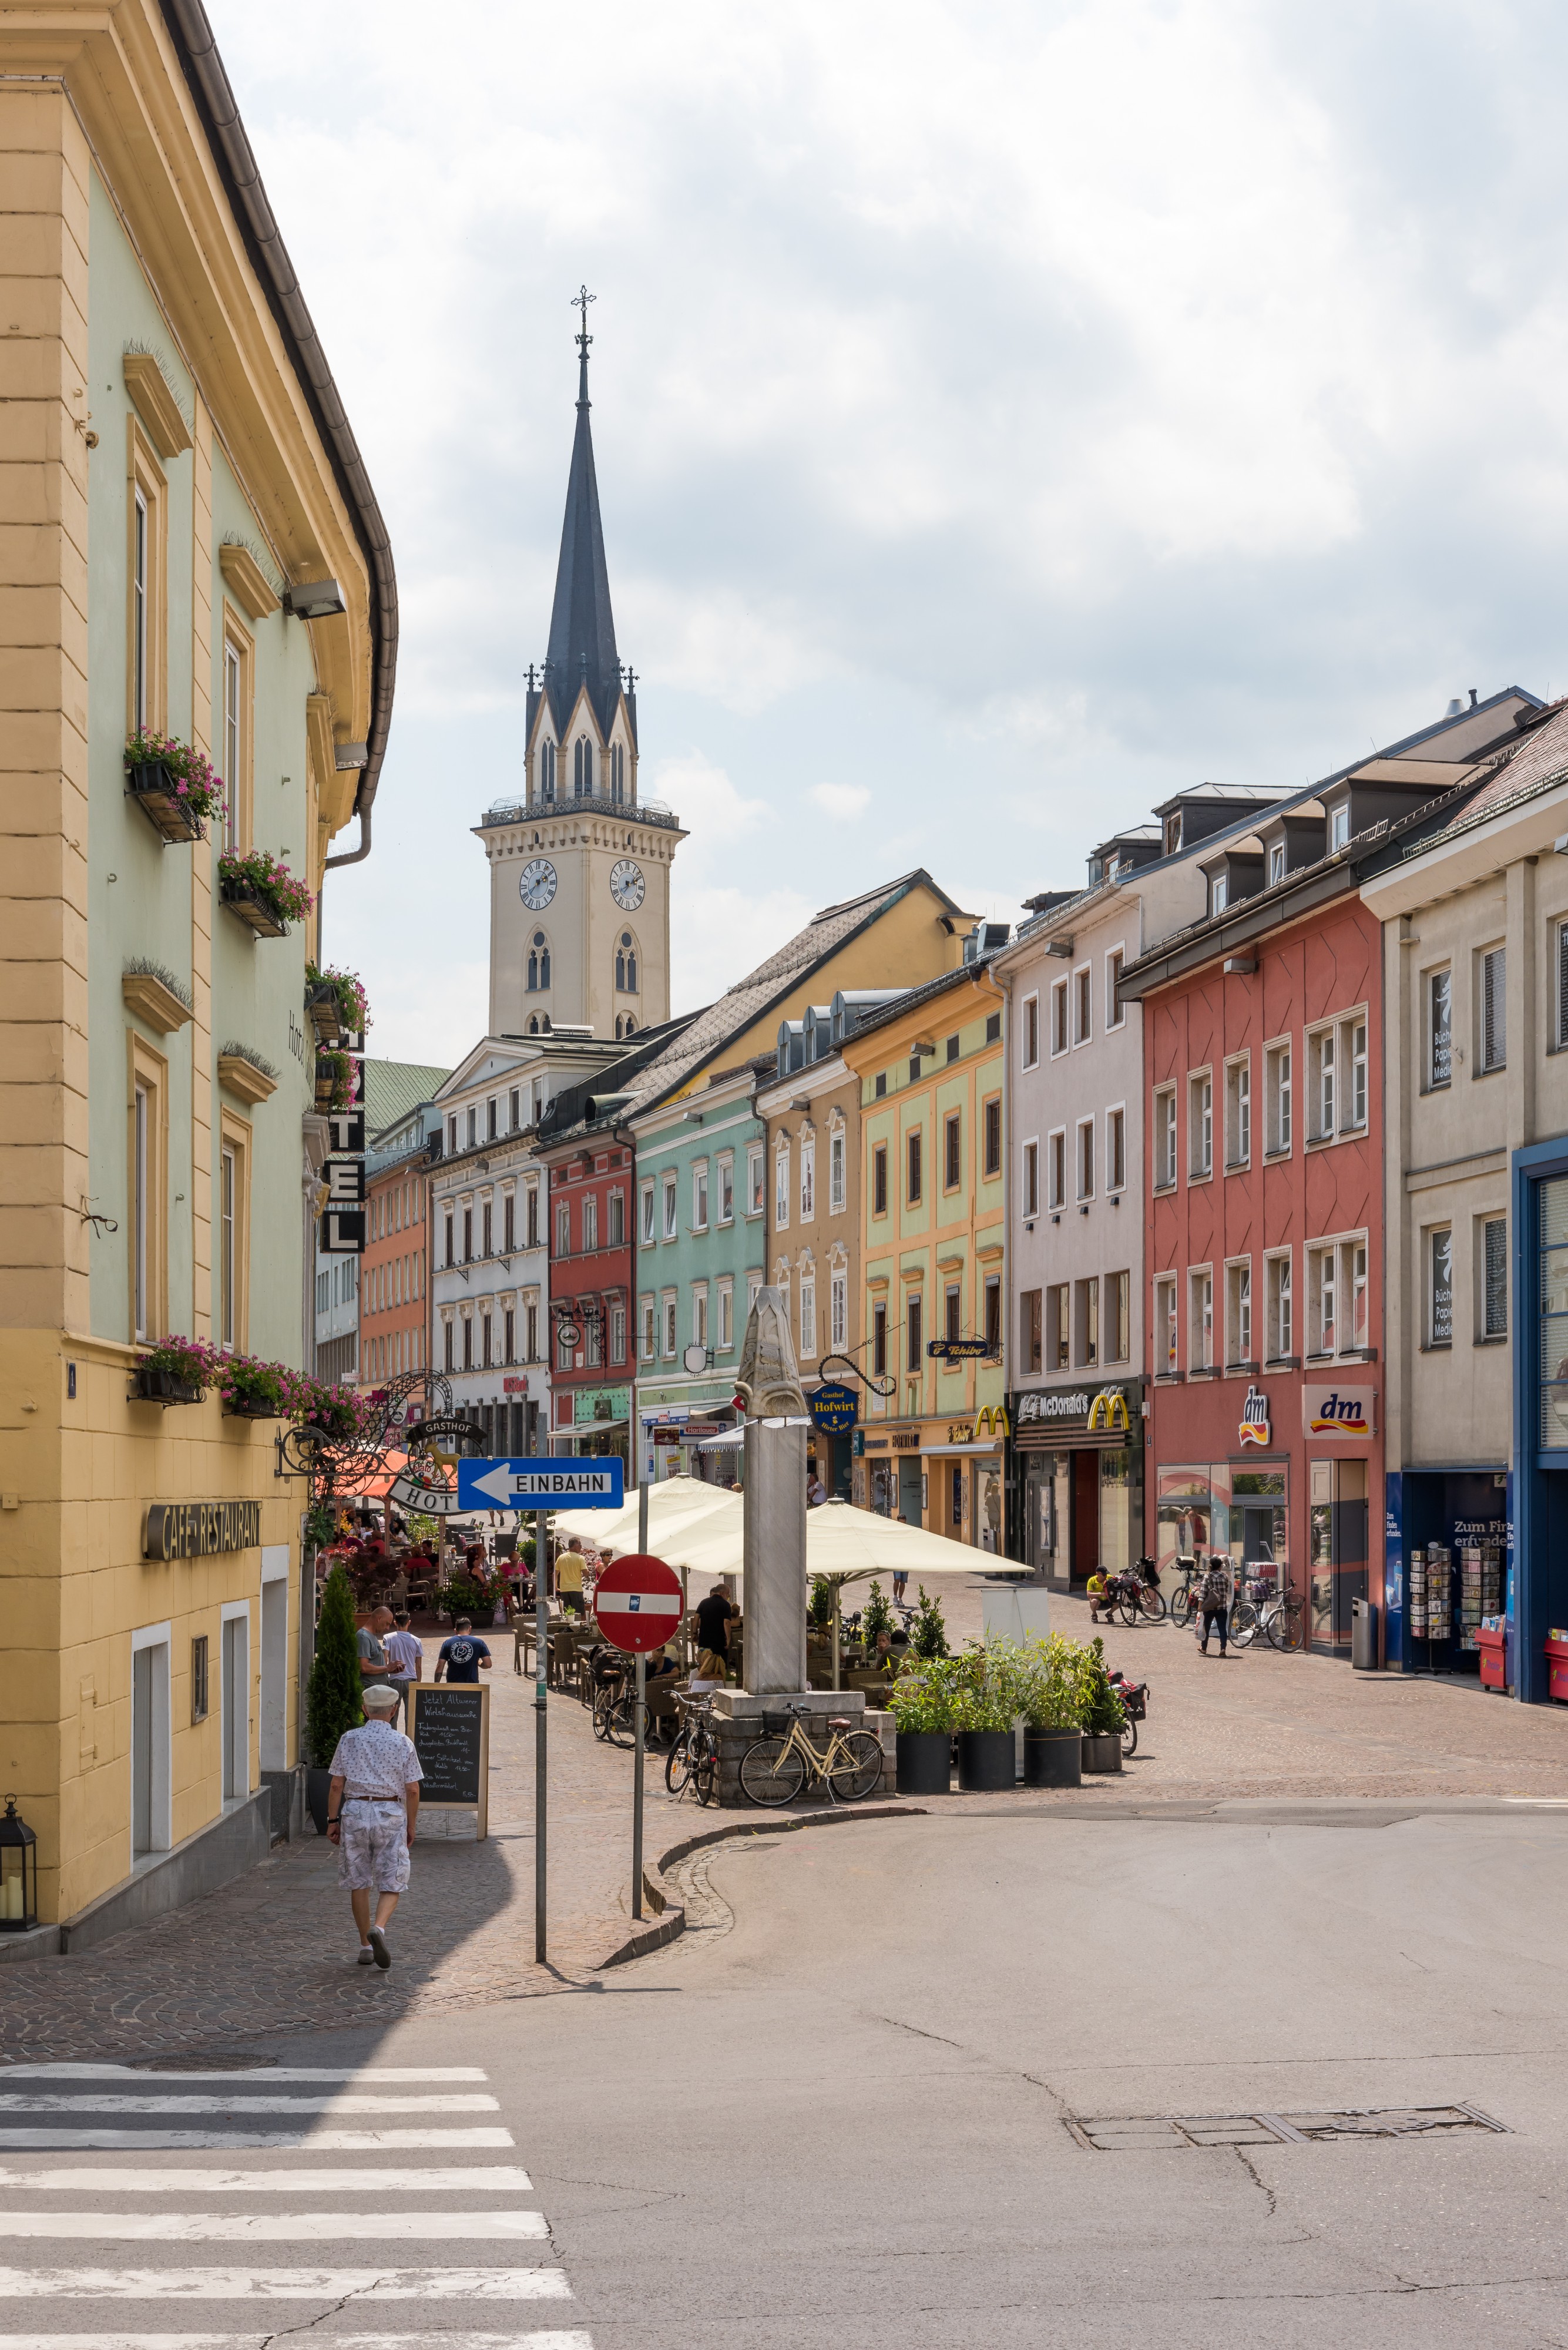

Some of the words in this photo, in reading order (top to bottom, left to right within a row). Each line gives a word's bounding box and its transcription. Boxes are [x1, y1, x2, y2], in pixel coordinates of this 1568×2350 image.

[328, 1027, 359, 1249] TEL
[948, 1345, 985, 1355] Tchibo
[814, 1402, 855, 1412] Hofwirt
[1040, 1393, 1089, 1416] McDonald's
[1245, 1388, 1264, 1423] dm
[1320, 1394, 1362, 1419] dm
[425, 1422, 472, 1433] GASTHOF
[821, 1422, 838, 1432] Hirter
[838, 1421, 850, 1431] Bier
[892, 1434, 915, 1448] HOFWIRT
[516, 1475, 603, 1492] EINBAHN
[405, 1487, 458, 1511] HOT
[162, 1505, 192, 1561] CAFE
[200, 1500, 263, 1555] RESTAURANT
[1455, 1521, 1485, 1532] Zum
[423, 1692, 443, 1704] Jetzt
[446, 1694, 478, 1704] Altwiener
[425, 1706, 478, 1718] Wirtshauswoche
[437, 1753, 462, 1763] Schnitzel
